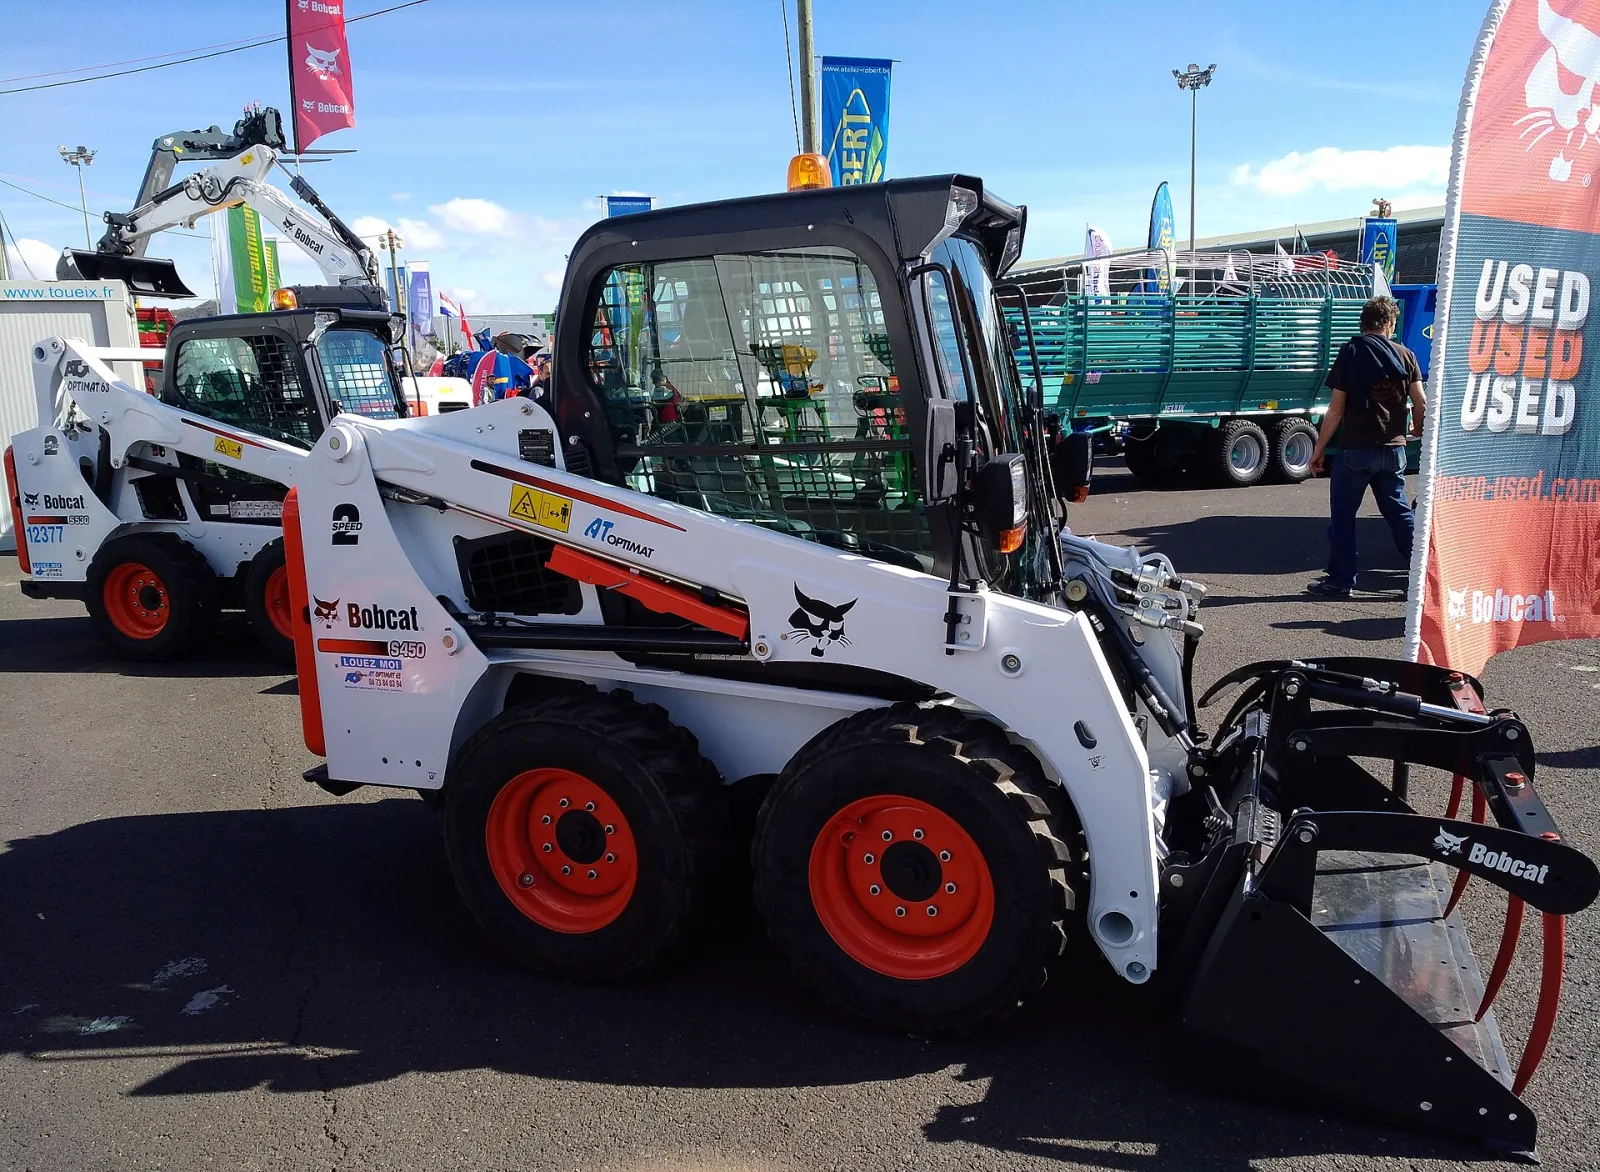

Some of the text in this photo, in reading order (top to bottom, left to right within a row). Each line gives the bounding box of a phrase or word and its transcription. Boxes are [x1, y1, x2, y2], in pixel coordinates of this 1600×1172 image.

[312, 1, 342, 14] Bobcat
[318, 102, 350, 114] Bobcat
[294, 227, 325, 256] Bobcat
[3, 286, 114, 298] www.toueix.fr
[1475, 258, 1590, 331] USED
[1468, 317, 1583, 380] USED
[68, 380, 110, 393] OPTIMAT 63
[1460, 372, 1576, 436] USED
[44, 435, 58, 456] 2
[43, 494, 85, 510] Bobcat
[68, 515, 90, 526] S530
[331, 503, 360, 546] 2
[332, 522, 363, 532] SPEED
[27, 526, 64, 544] 12377
[583, 517, 655, 558] AT OPTIMAT
[1472, 588, 1556, 624] Bobcat
[347, 602, 420, 632] Bobcat
[389, 640, 427, 659] S450
[343, 658, 399, 669] LOUEZ MOI
[1468, 842, 1549, 885] Bobcat
